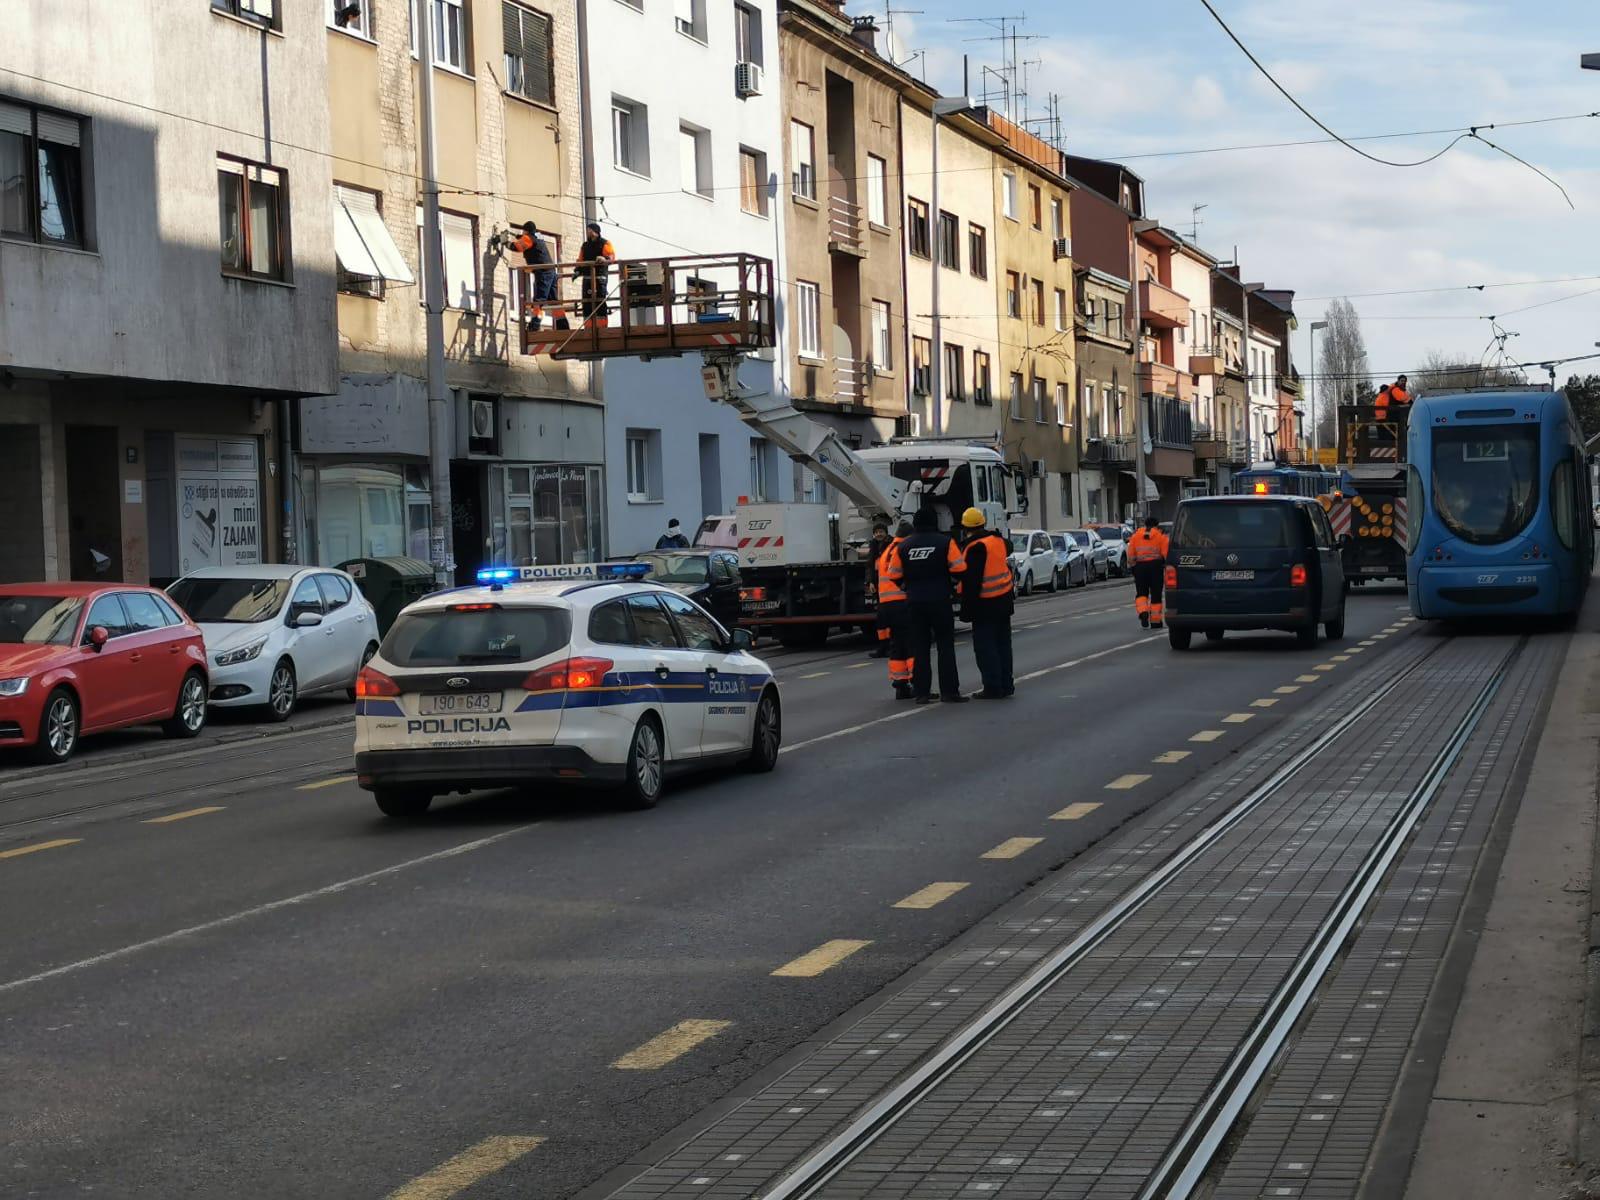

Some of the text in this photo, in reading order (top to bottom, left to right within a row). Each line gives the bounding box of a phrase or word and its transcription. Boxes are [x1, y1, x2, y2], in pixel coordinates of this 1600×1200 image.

[1476, 443, 1495, 457] 12
[233, 502, 256, 522] mini
[223, 526, 256, 546] ZAJAM
[523, 566, 593, 578] POLICIJA
[709, 681, 739, 694] POLICIJA
[465, 695, 490, 709] 643
[407, 717, 511, 734] POLICIJA
